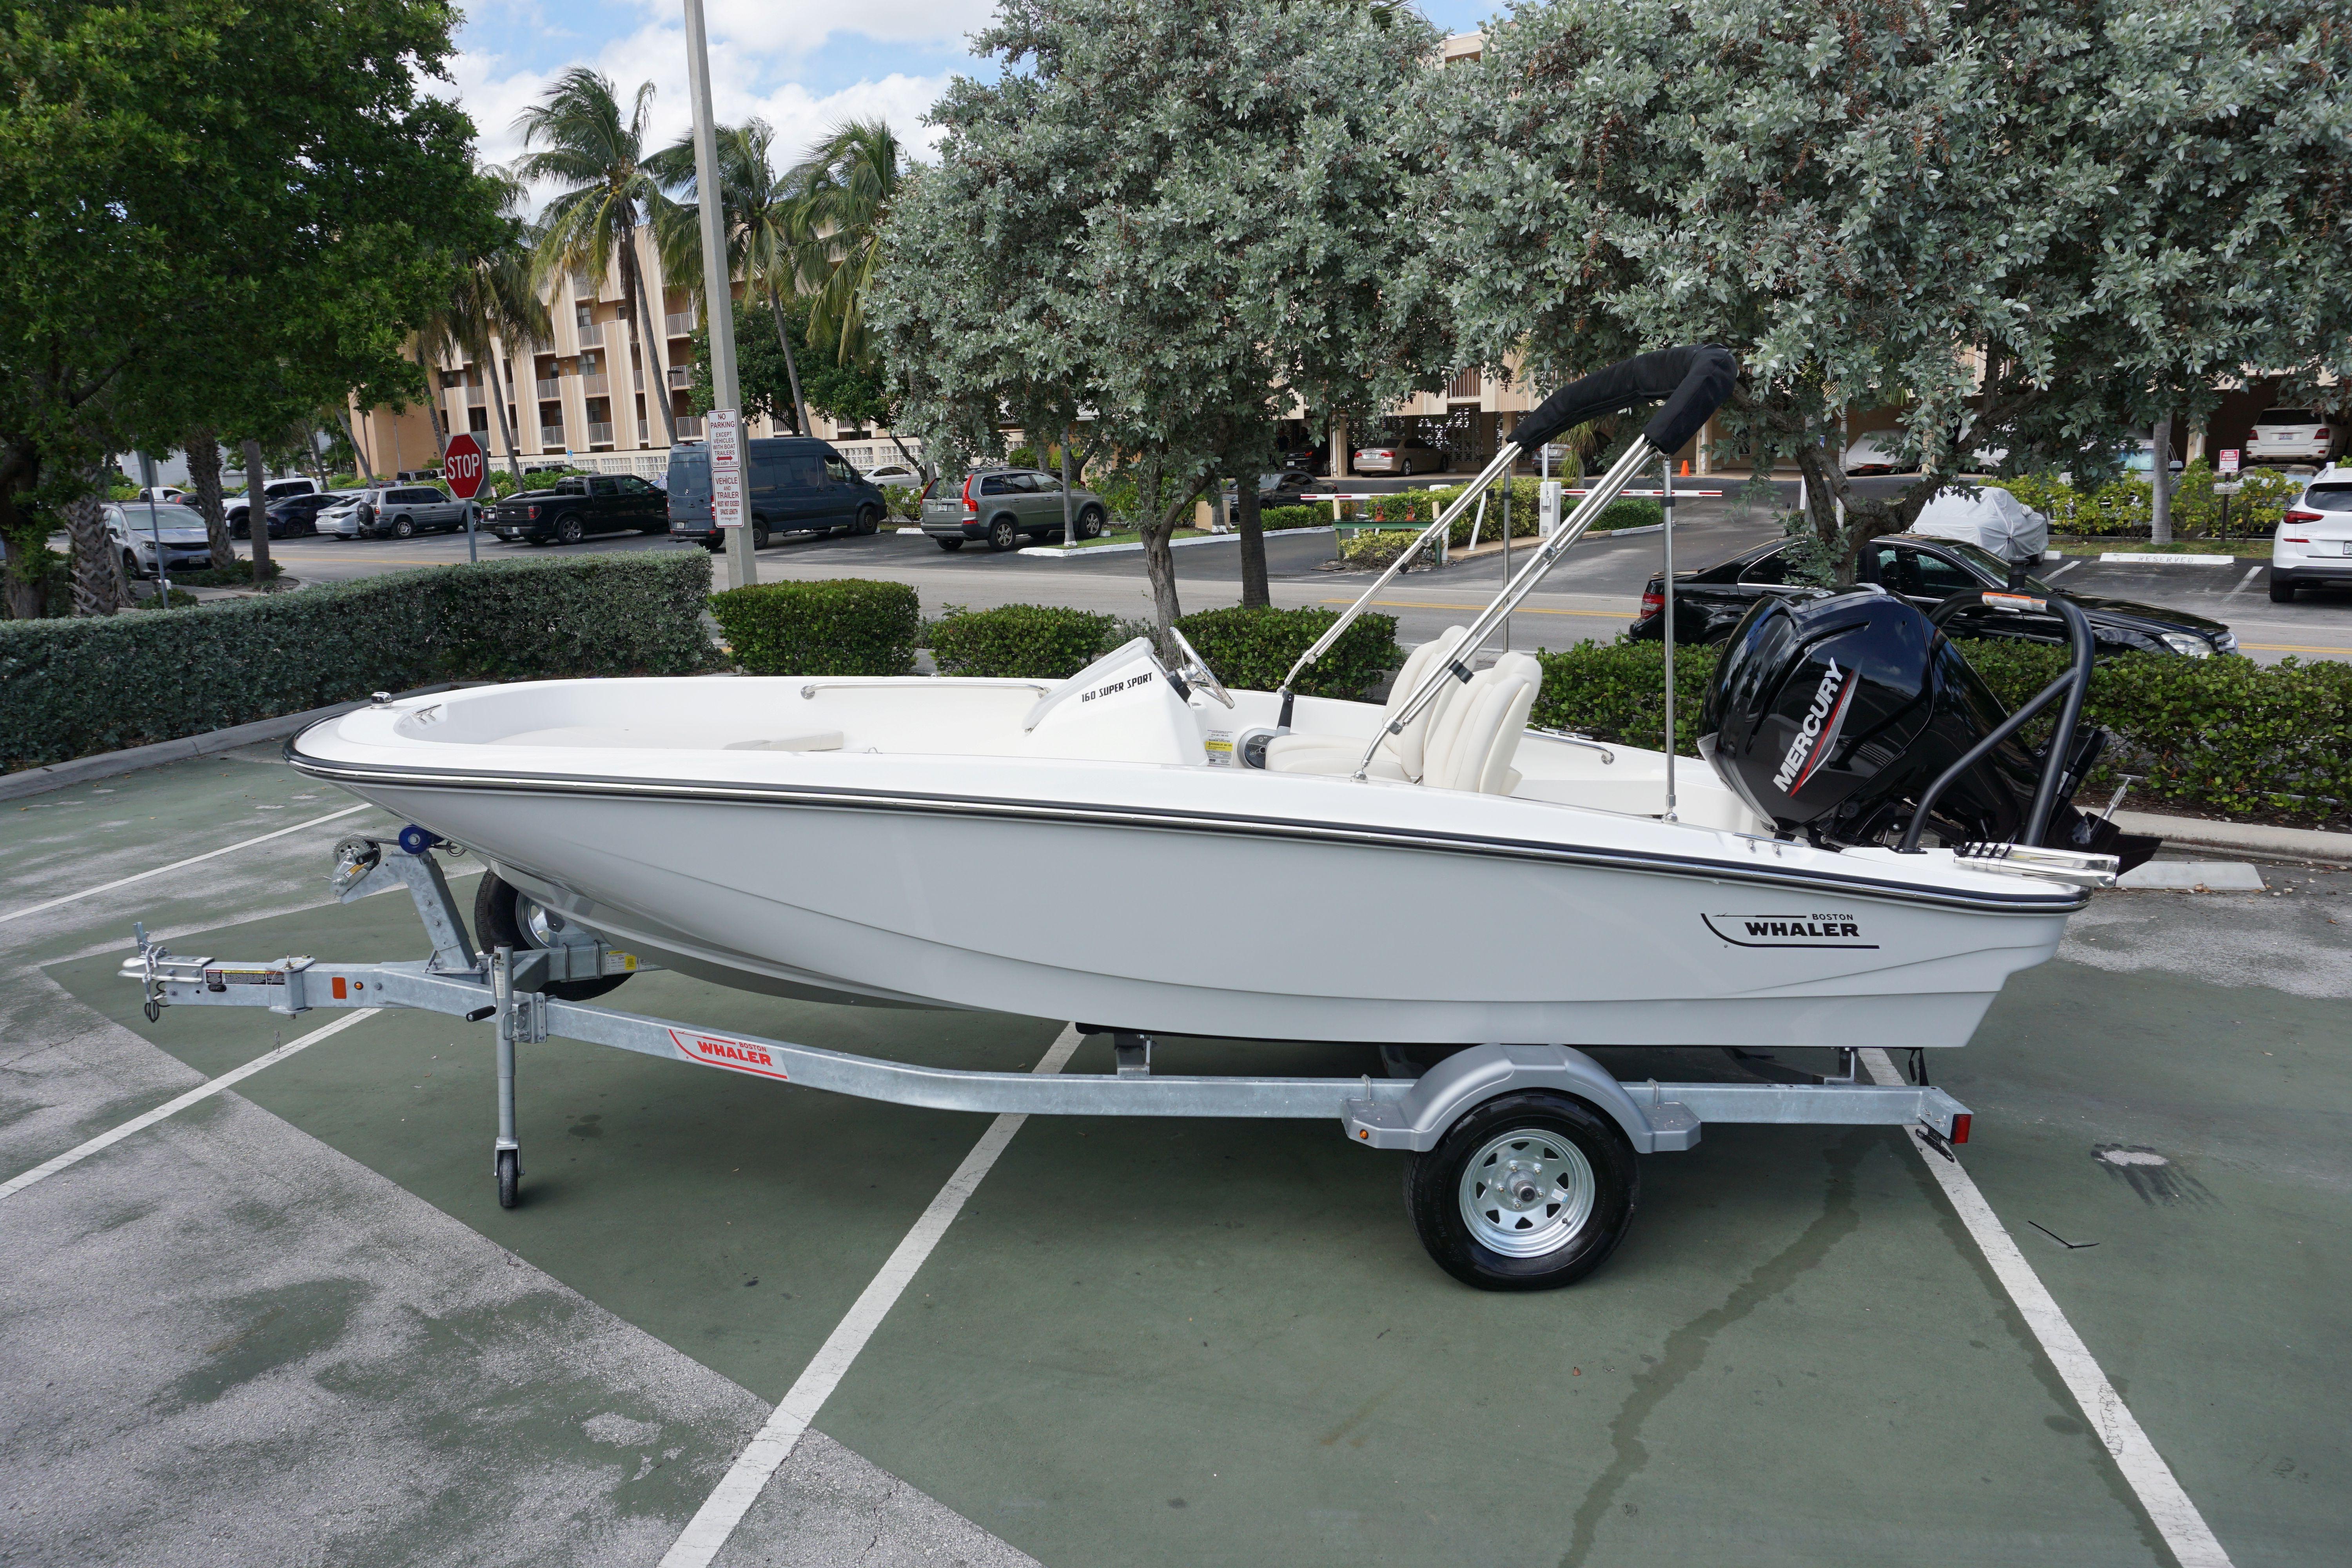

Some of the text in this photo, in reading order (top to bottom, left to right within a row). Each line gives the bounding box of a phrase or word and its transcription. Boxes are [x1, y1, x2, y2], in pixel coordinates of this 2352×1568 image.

[448, 453, 479, 479] STOP
[2138, 555, 2194, 563] RESERVED
[1082, 672, 1152, 702] 160 SUPER SPORT
[1773, 657, 1843, 792] MERCURY
[1744, 922, 1860, 936] WHALER
[697, 1041, 773, 1066] WHALER
[739, 1042, 767, 1052] BOSTON
